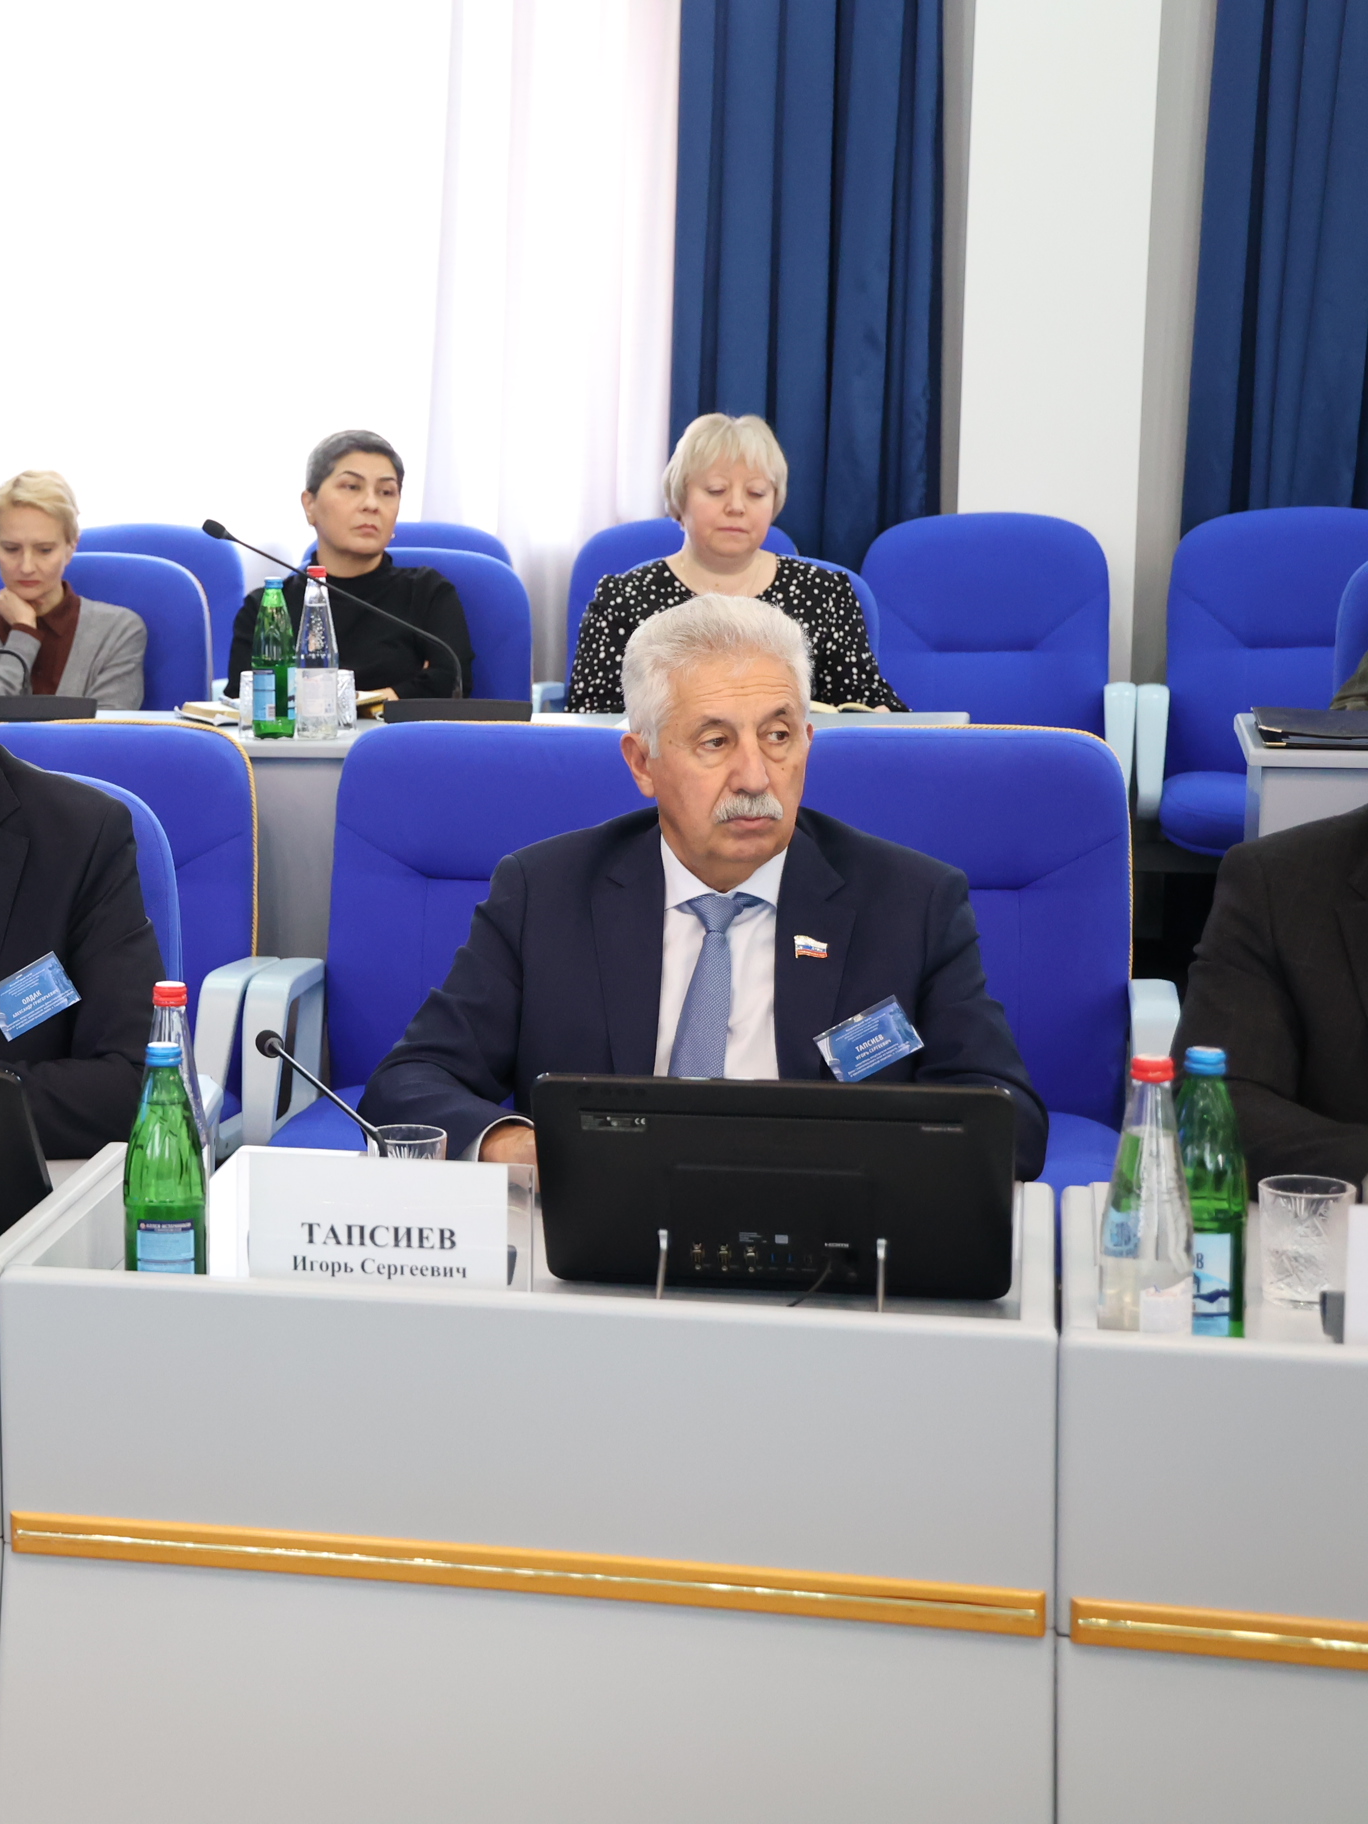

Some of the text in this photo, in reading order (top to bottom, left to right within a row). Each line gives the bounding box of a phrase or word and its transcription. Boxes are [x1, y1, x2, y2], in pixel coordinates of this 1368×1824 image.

[21, 989, 43, 1005] ОЛДАК
[855, 1033, 884, 1053] ТАПСИЕВ
[301, 1222, 457, 1250] ТАПСИЕВ
[292, 1255, 467, 1280] Игорь Сергеевич
